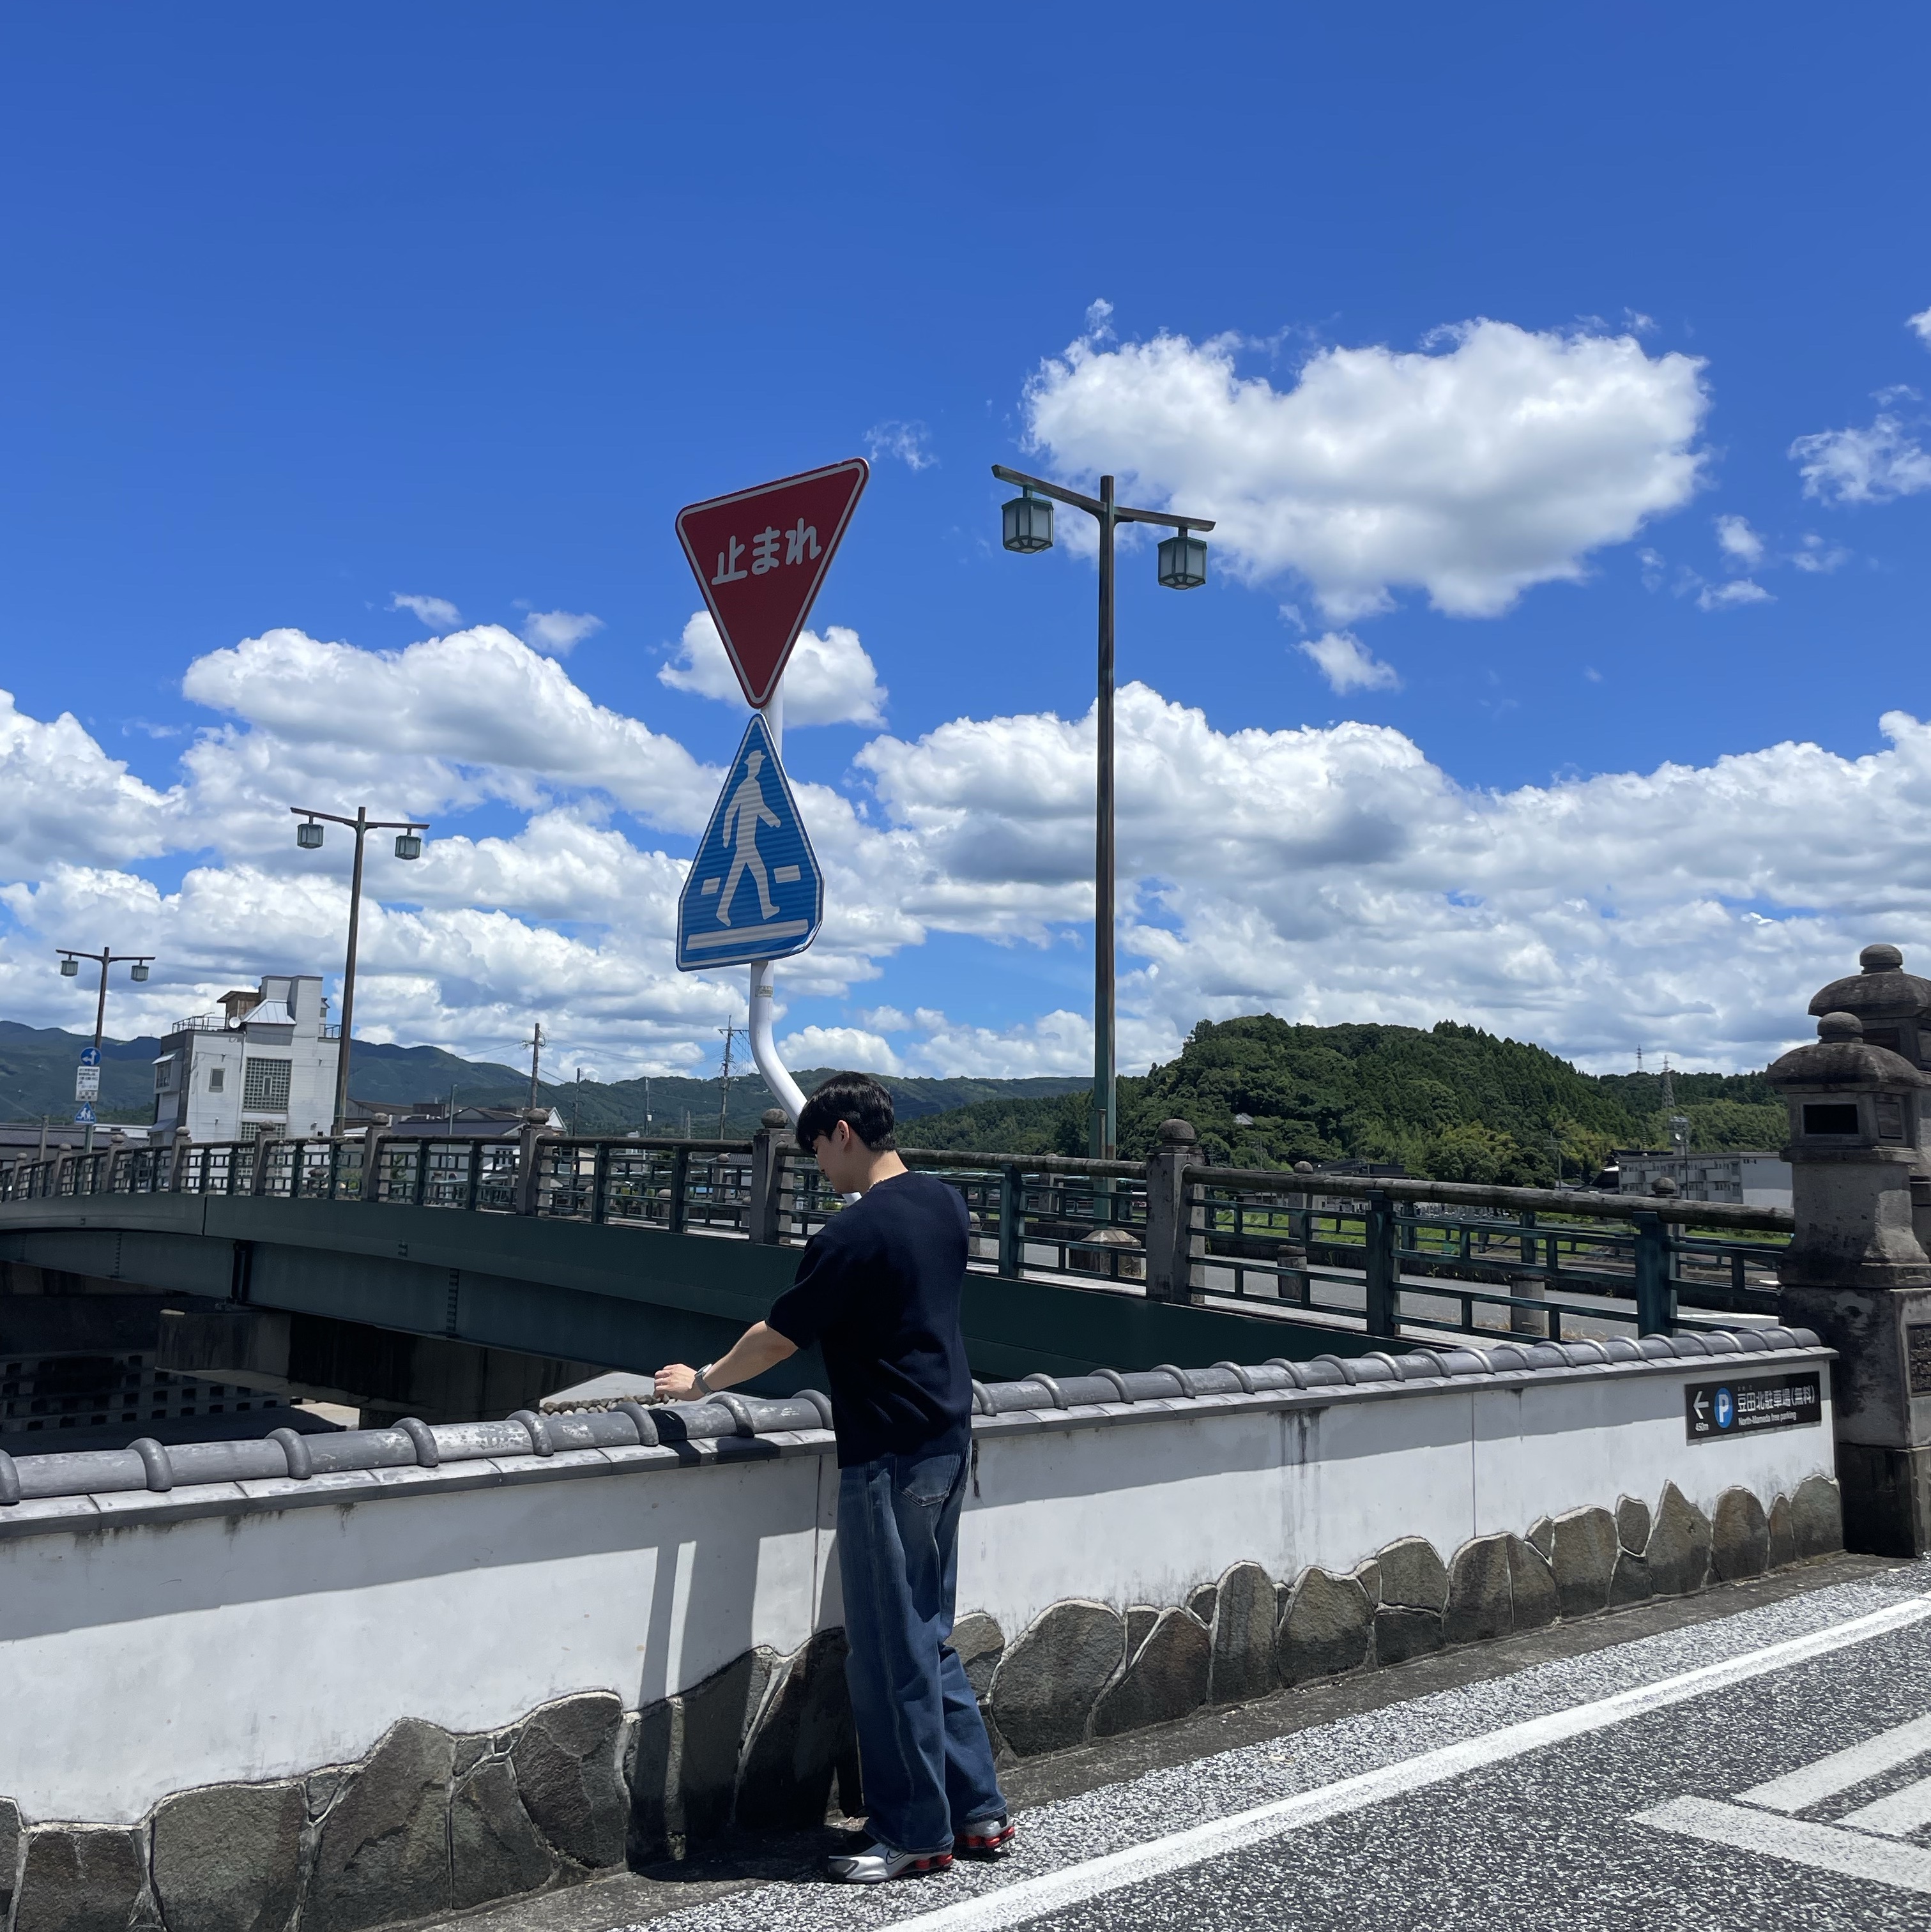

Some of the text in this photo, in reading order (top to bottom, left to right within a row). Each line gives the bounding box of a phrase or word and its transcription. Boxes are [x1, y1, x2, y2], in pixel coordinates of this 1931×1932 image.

[711, 517, 821, 585] 止まれ
[1718, 1394, 1729, 1423] P
[1737, 1385, 1815, 1413] 豆田北駐車場(無料)
[1780, 1411, 1797, 1422] parking
